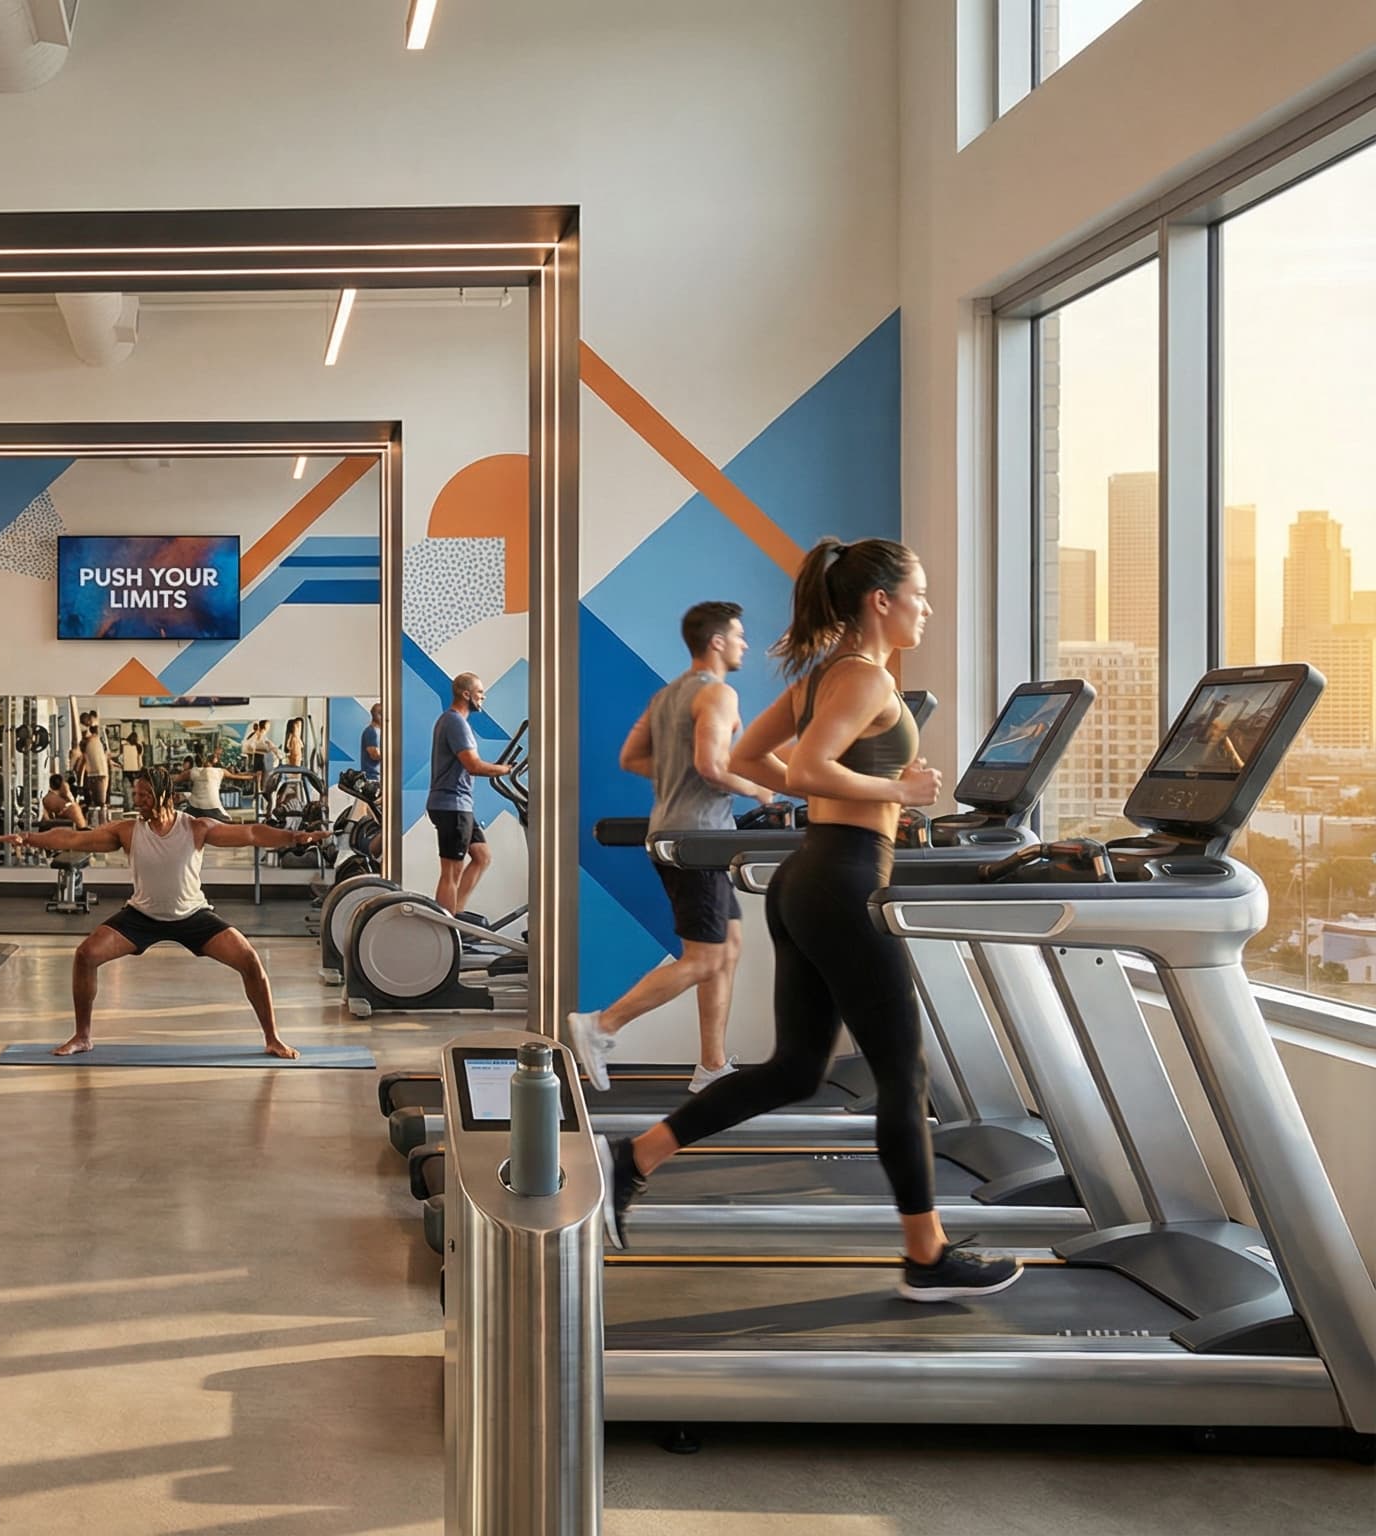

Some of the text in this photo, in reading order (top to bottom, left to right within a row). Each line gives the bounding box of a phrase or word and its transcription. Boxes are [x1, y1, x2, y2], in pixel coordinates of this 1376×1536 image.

[79, 567, 218, 587] PUSH YOUR
[110, 589, 187, 609] LIMITS
